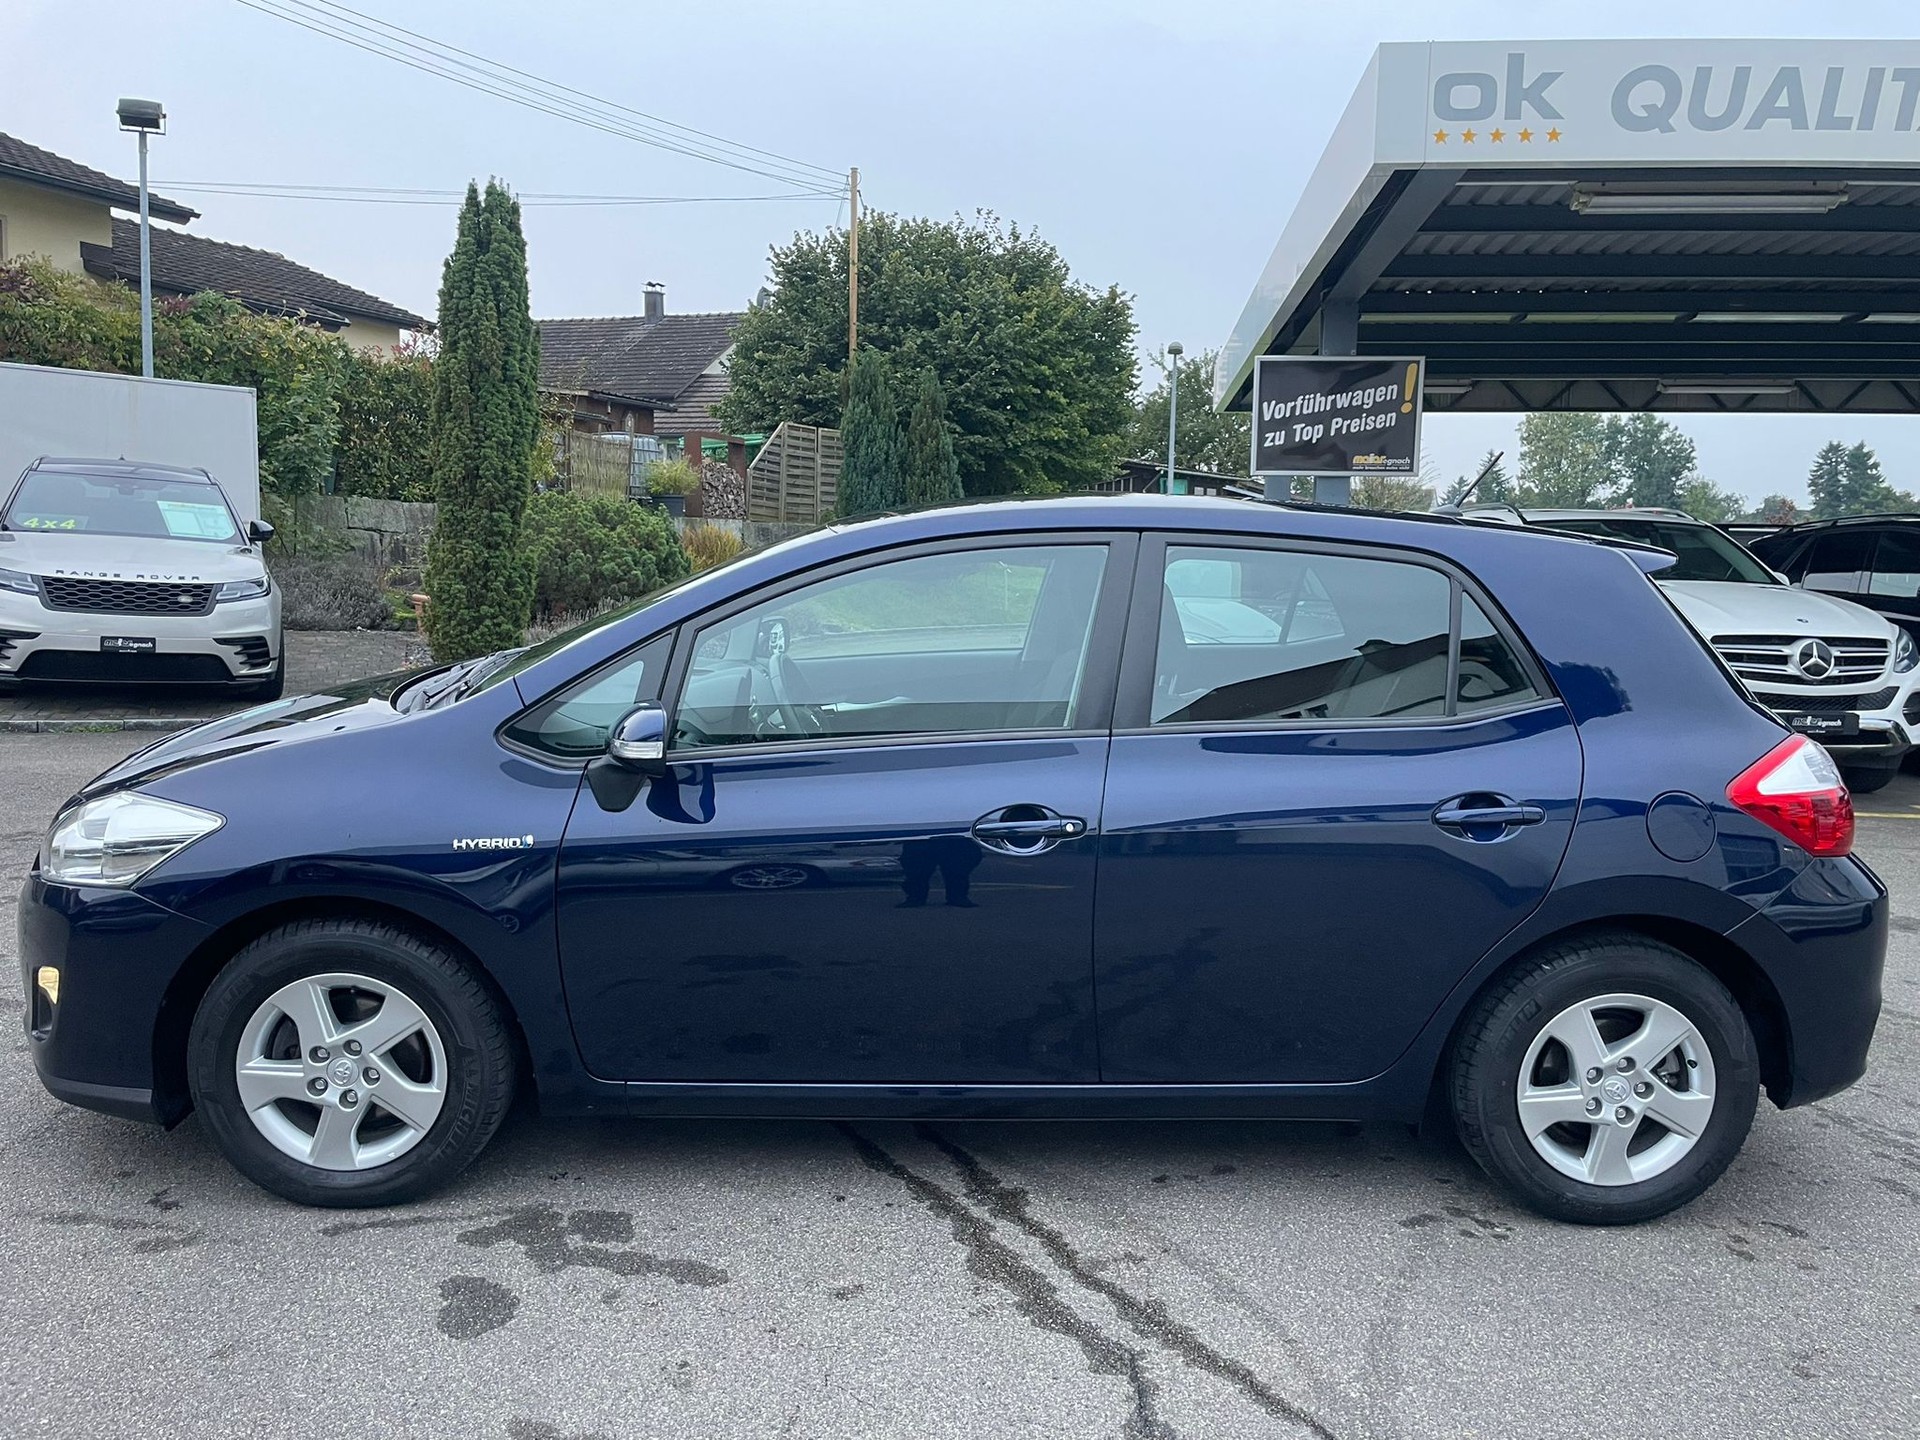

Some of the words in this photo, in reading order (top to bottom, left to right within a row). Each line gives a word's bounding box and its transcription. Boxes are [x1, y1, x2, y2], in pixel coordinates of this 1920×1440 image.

[1433, 53, 1565, 121] ok
[1611, 64, 1920, 134] QUALIT
[1262, 383, 1398, 421] Vorführwagen
[1263, 430, 1286, 447] zu
[1292, 423, 1324, 444] Top
[1330, 411, 1397, 437] Preisen
[56, 569, 121, 578] RANGE
[136, 573, 200, 581] ROVER
[452, 838, 521, 850] HYBRID
